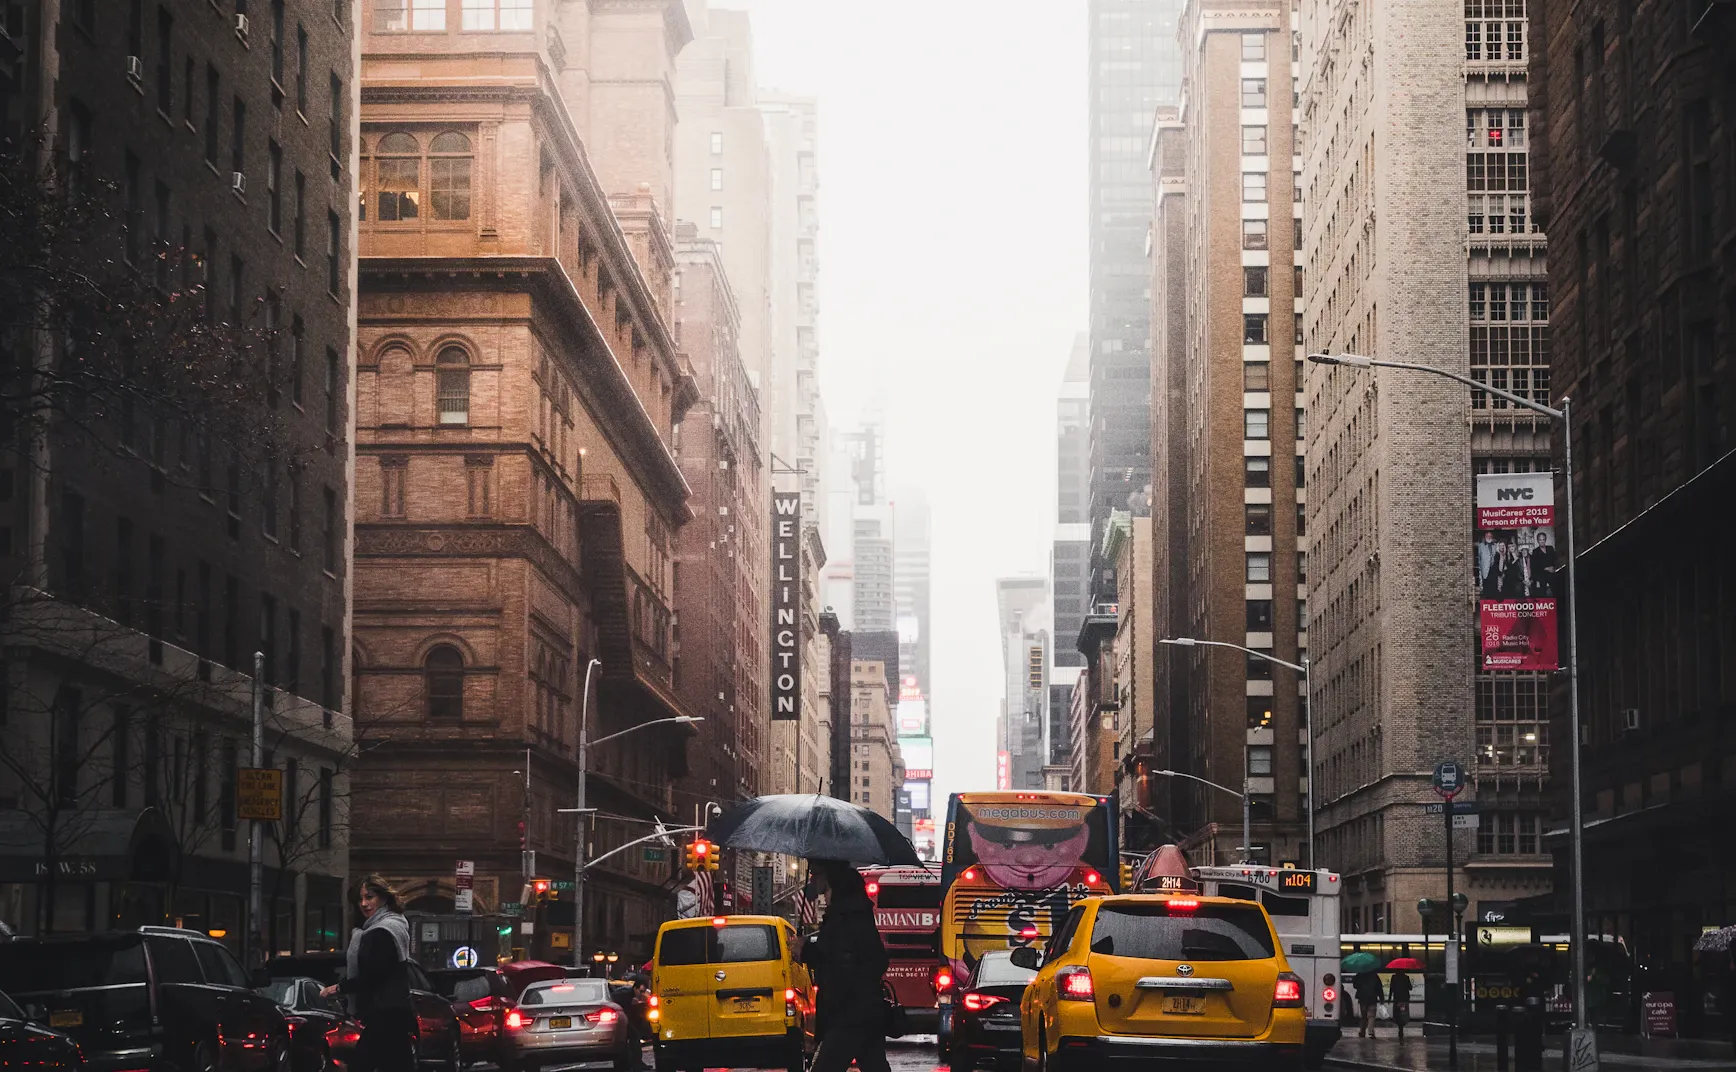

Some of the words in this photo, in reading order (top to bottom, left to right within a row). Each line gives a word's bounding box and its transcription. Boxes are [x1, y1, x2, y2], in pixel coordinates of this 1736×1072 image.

[1497, 488, 1534, 501] NYC
[1526, 508, 1548, 516] 2018
[1482, 518, 1510, 526] Person
[1510, 517, 1518, 525] of
[1519, 517, 1532, 525] the
[775, 499, 798, 712] WELLINGTON
[1482, 603, 1534, 611] FLEETWOOD
[1535, 602, 1554, 610] MAC
[1485, 632, 1499, 641] 26
[1518, 634, 1529, 642] City
[1426, 803, 1443, 813] M20
[978, 807, 1080, 820] megabus.com
[946, 822, 956, 864] DD769
[80, 862, 96, 875] 58
[1162, 877, 1182, 889] 2H14
[1248, 874, 1270, 884] 6700
